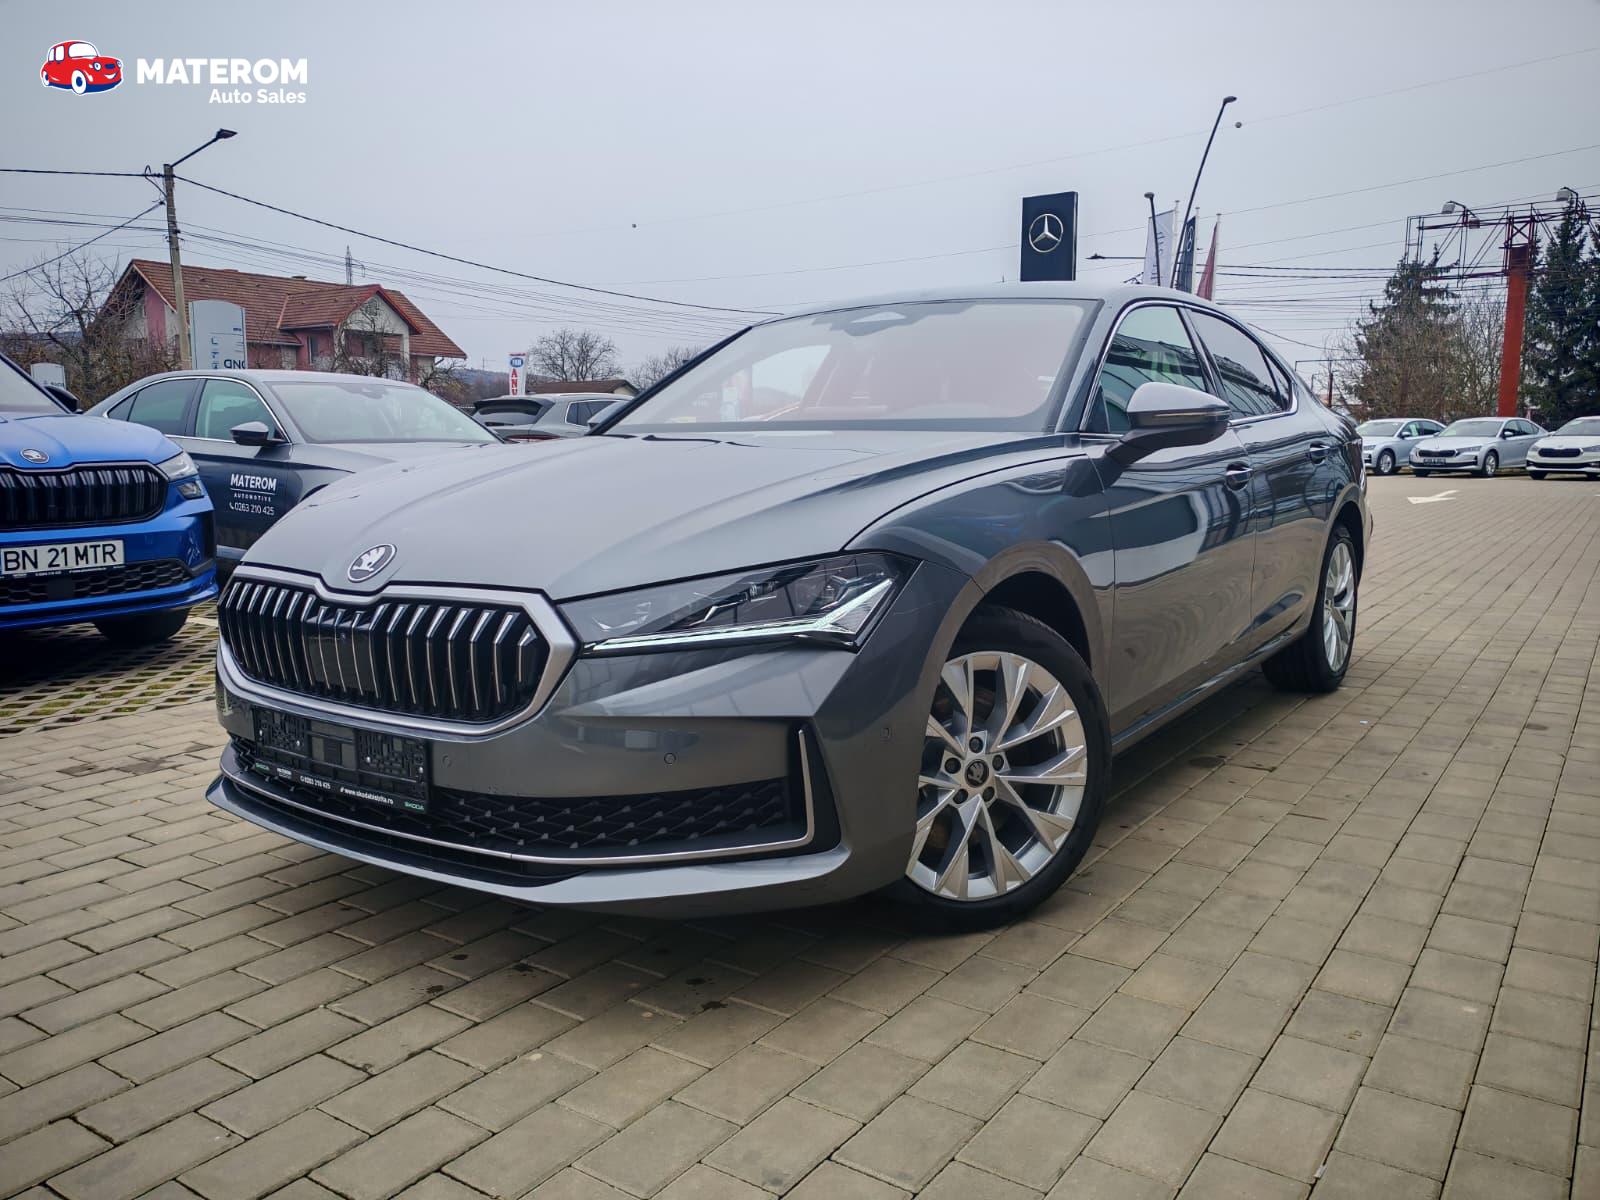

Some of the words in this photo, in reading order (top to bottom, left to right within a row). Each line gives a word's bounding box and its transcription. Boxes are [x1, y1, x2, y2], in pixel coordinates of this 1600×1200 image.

[230, 473, 277, 491] MATEROM
[234, 502, 250, 512] 0263
[262, 506, 275, 516] 425
[3, 549, 38, 572] BN
[48, 547, 68, 568] 21
[74, 543, 117, 566] MTR
